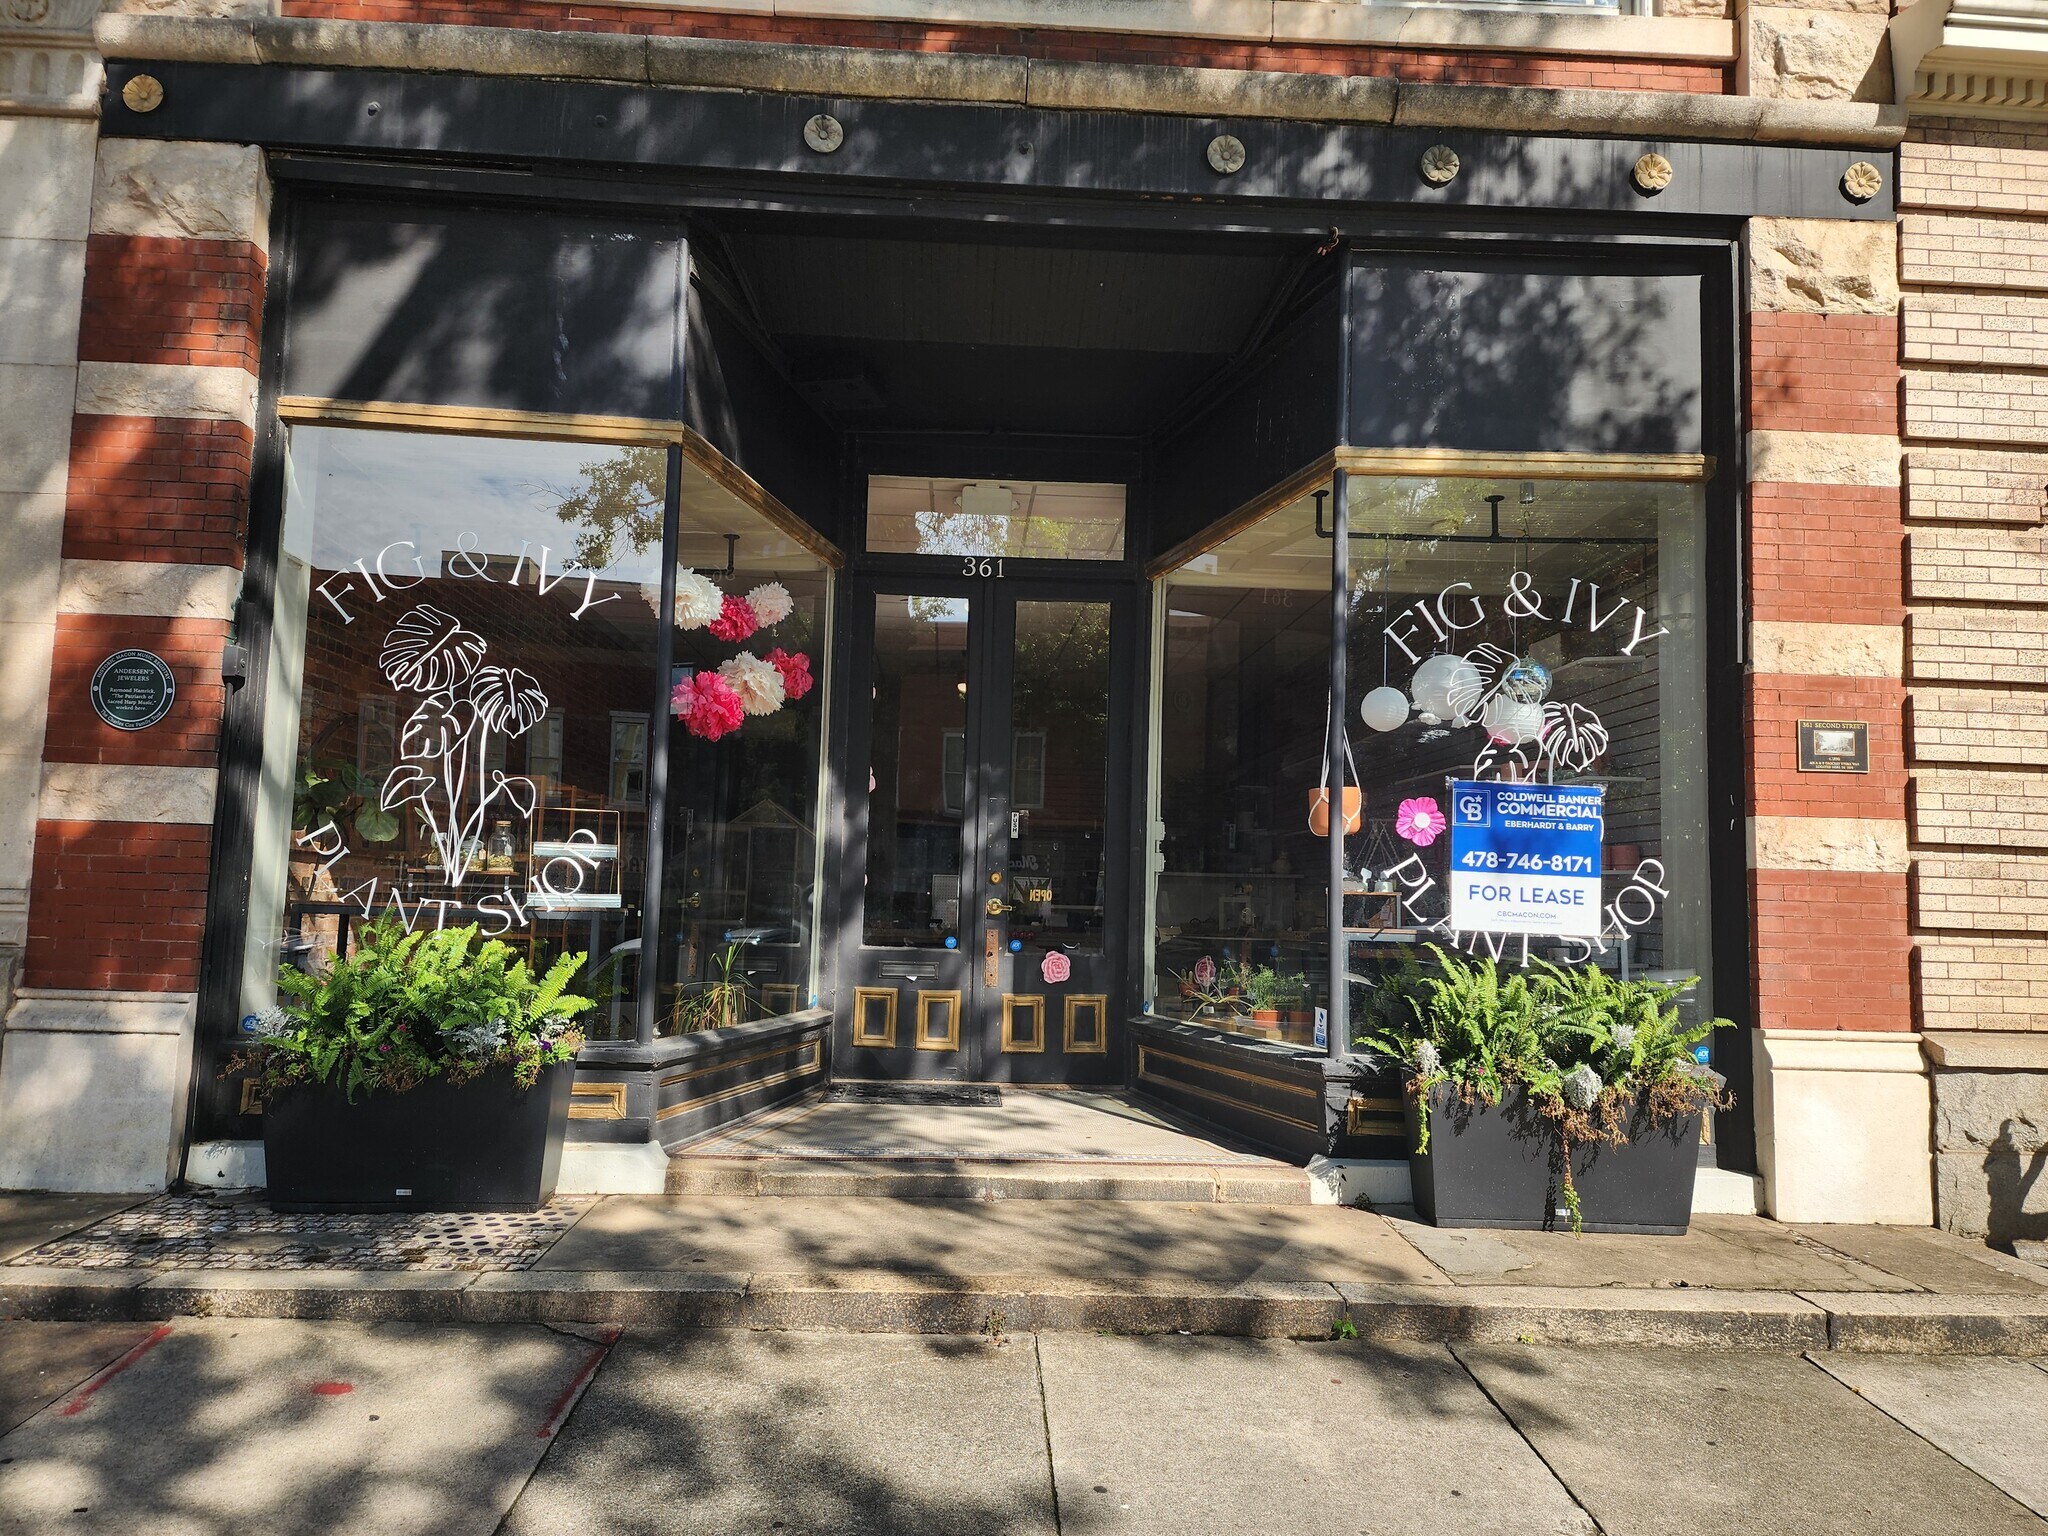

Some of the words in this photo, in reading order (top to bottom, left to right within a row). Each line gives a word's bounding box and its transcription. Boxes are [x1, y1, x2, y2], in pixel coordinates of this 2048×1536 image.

[315, 541, 426, 624] FIG
[448, 531, 498, 583] &
[508, 539, 622, 621] IVY
[962, 556, 1004, 578] 361
[1383, 582, 1485, 665] FIG
[1503, 571, 1552, 621] &
[1561, 578, 1670, 656] IVY
[97, 658, 115, 678] HISTORIC
[115, 652, 136, 660] MACON
[137, 652, 154, 660] MUSIC
[154, 659, 171, 680] REGISTRY
[108, 716, 124, 726] Charles
[150, 712, 162, 721] Trust
[1497, 792, 1556, 804] COLDWELL
[1558, 795, 1601, 806] BANKER
[1497, 802, 1602, 818] COMMERCIAL
[1504, 820, 1556, 830] EBERHARDT
[1566, 824, 1594, 832] BARRY
[1462, 850, 1592, 873] 478-746-8171
[476, 829, 601, 937] SHOP
[1469, 884, 1511, 902] FOR
[1520, 888, 1584, 906] LEASE
[1497, 910, 1556, 919] CBCMACON.COM
